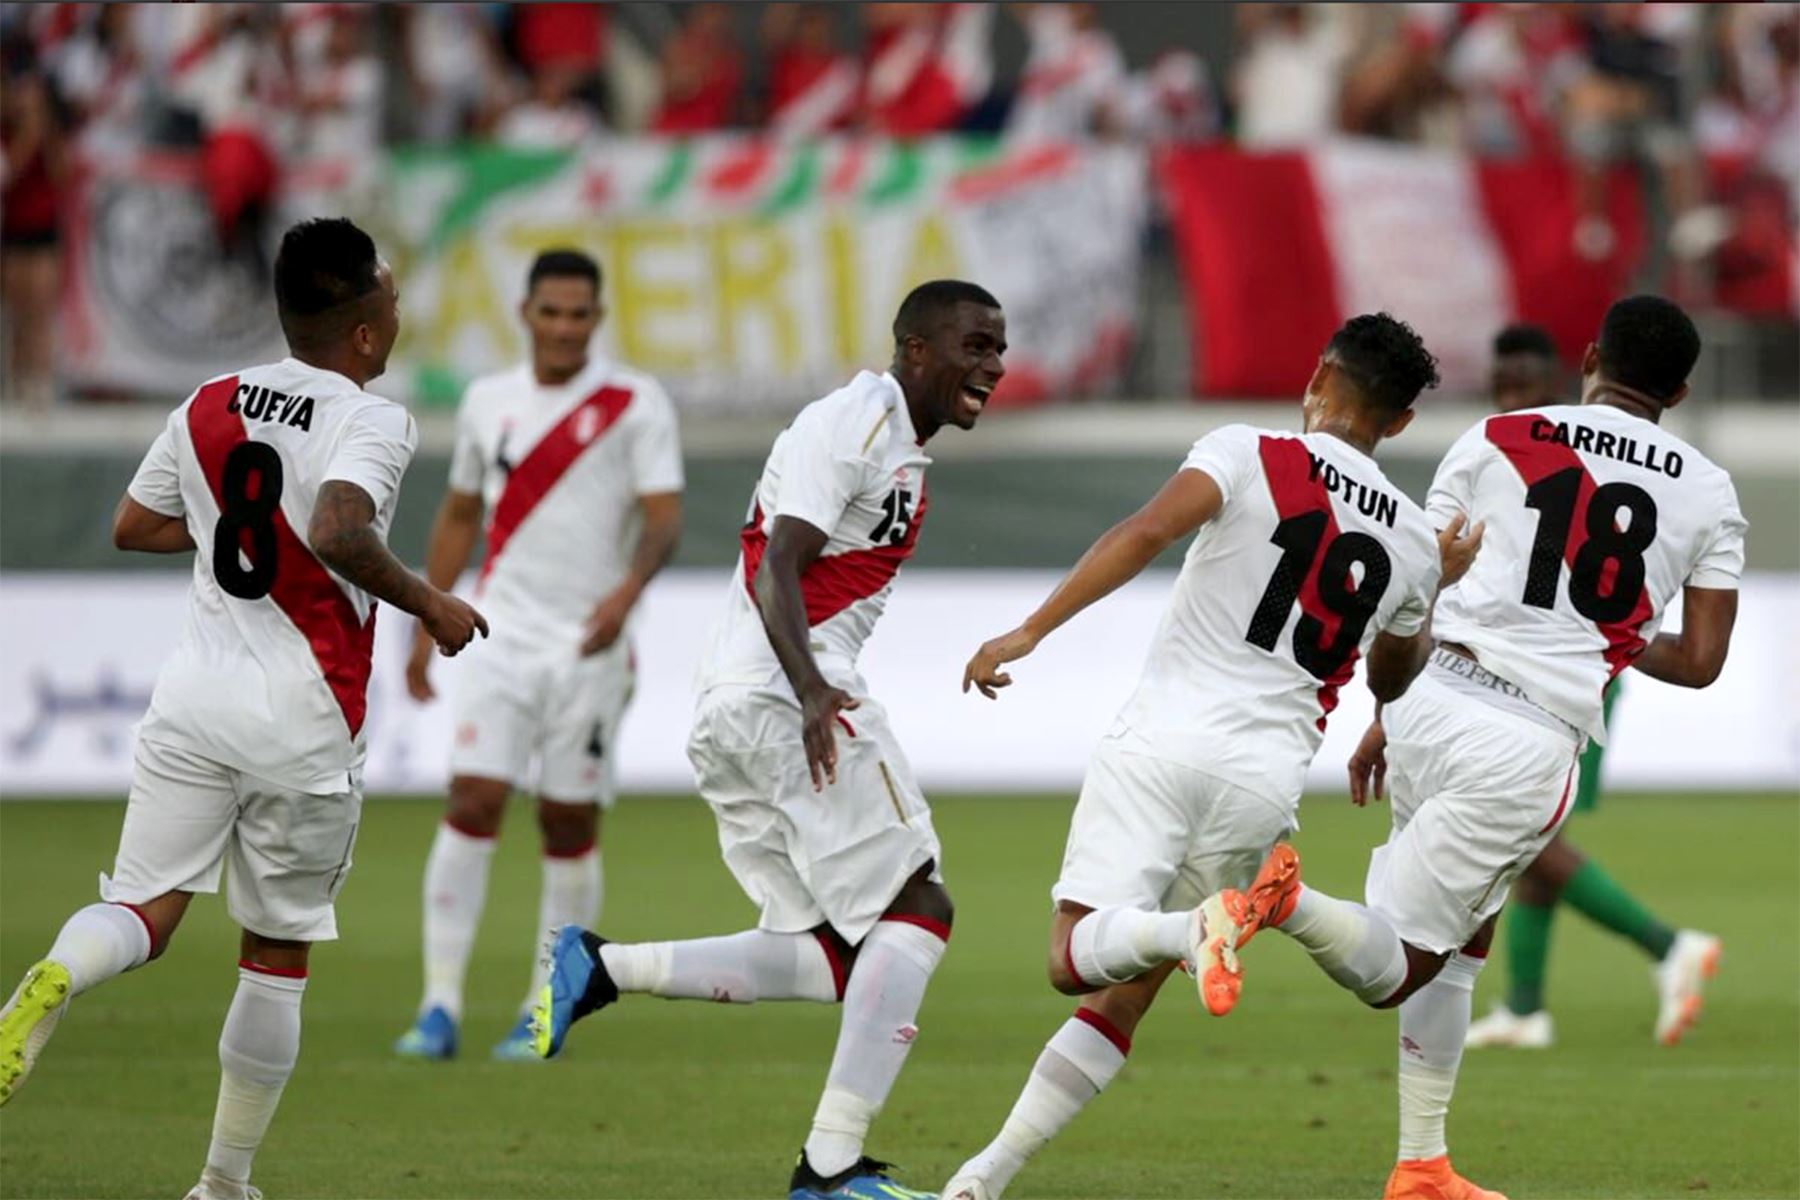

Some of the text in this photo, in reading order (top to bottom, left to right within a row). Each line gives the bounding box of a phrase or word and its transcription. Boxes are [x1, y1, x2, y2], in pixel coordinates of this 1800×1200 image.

[228, 384, 315, 432] CUEVA
[1529, 419, 1684, 479] CARRILLO
[213, 440, 284, 600] 8
[868, 488, 912, 547] 15
[1306, 452, 1398, 529] YOTUN
[1521, 466, 1658, 623] 18
[1245, 509, 1392, 681] 19
